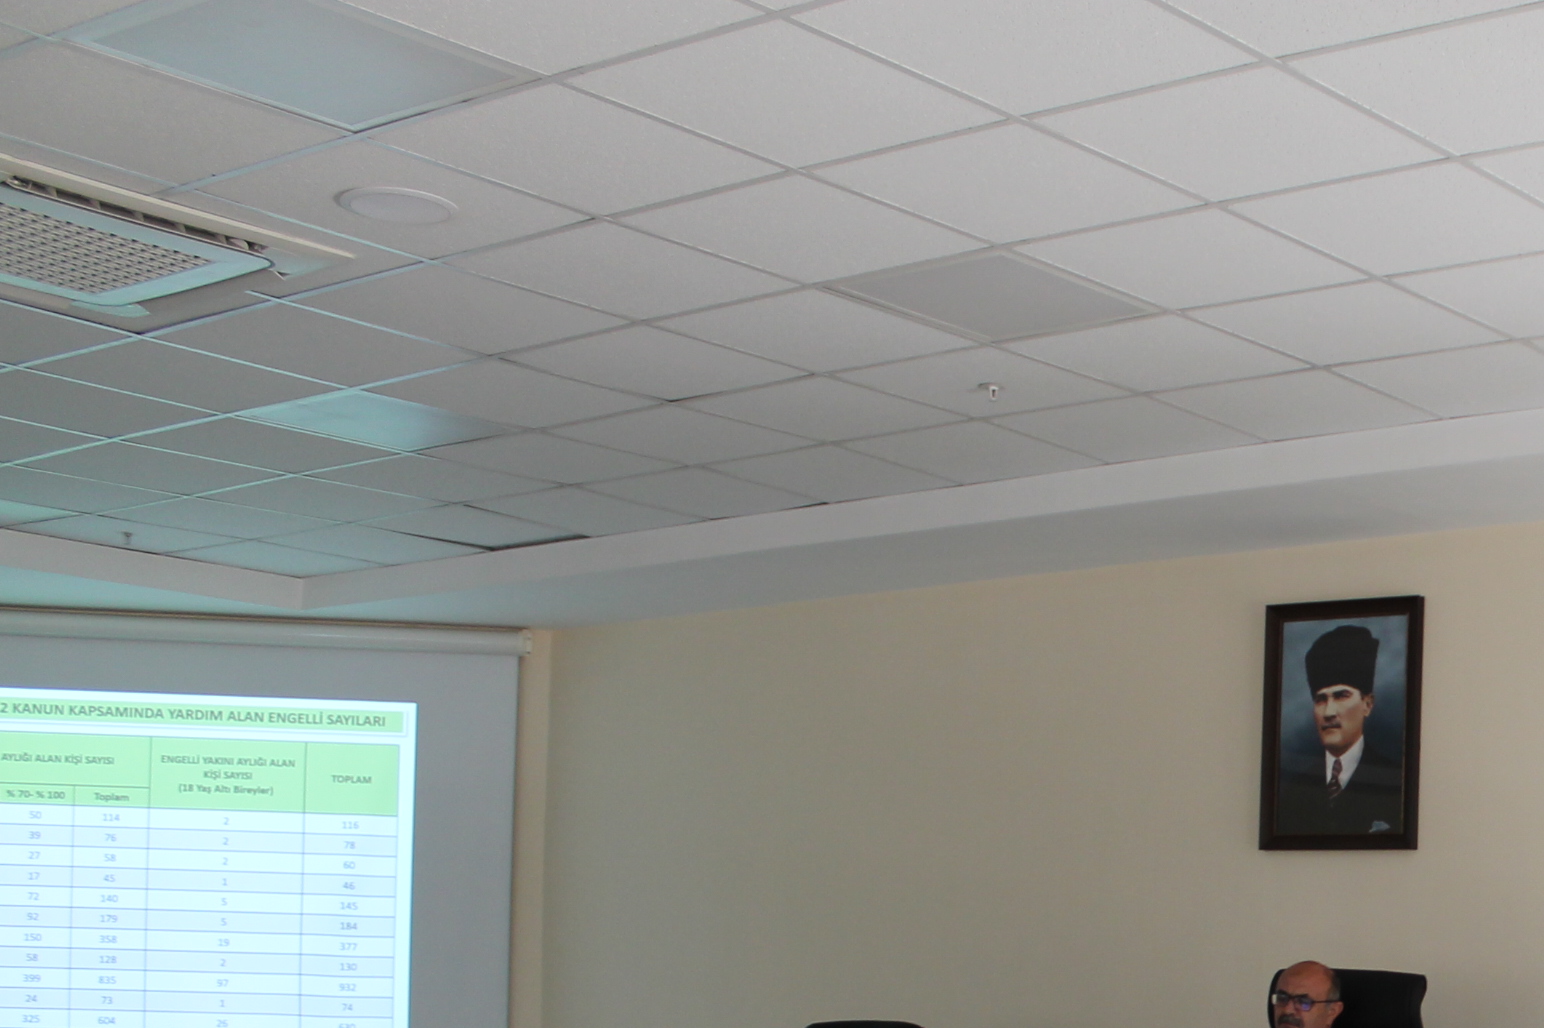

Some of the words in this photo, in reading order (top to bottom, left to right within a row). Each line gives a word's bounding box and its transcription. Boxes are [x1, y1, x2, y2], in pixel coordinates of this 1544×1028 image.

[12, 703, 65, 715] KANUN
[69, 705, 165, 719] KAPSAMINDA
[168, 708, 223, 721] YARDIM
[227, 710, 264, 723] ALAN
[268, 711, 323, 725] ENGELLİ
[326, 714, 386, 727] SAYILARI
[35, 754, 62, 763] ALAN
[85, 755, 115, 765] SAYISI
[160, 753, 201, 765] ENGELLİ
[202, 755, 235, 766] YAKINI
[269, 758, 296, 768] ALAN
[223, 771, 253, 780] SAYISI
[331, 774, 373, 784] TOPLAM
[178, 782, 195, 794] (18
[233, 785, 274, 797] Bireyler)
[47, 790, 66, 800] 100
[94, 792, 130, 804] Toplam
[28, 810, 43, 820] 50
[102, 813, 121, 822] 114
[341, 820, 360, 830] 116
[27, 830, 42, 840] 39
[104, 832, 117, 843] 76
[343, 840, 356, 850] 78
[27, 850, 41, 860] 27
[103, 853, 117, 863] 58
[342, 860, 356, 870] 60
[27, 871, 41, 881] 17
[102, 874, 116, 883] 45
[342, 881, 356, 891] 46
[27, 891, 40, 901] 72
[100, 894, 119, 903] 140
[340, 901, 359, 911] 145
[25, 911, 39, 922] 92
[99, 913, 118, 924] 179
[339, 921, 358, 931] 184
[23, 932, 43, 942] 150
[98, 934, 118, 944] 358
[217, 937, 231, 948] 19
[339, 941, 358, 952] 377
[25, 952, 39, 962] 58
[99, 955, 117, 964] 128
[339, 962, 358, 972] 130
[22, 973, 41, 983] 399
[97, 975, 117, 985] 835
[216, 978, 230, 988] 97
[338, 982, 357, 993] 932
[24, 994, 38, 1003] 24
[100, 995, 114, 1005] 73
[341, 1002, 354, 1012] 74
[21, 1014, 41, 1024] 325
[97, 1016, 116, 1025] 604
[215, 1018, 229, 1028] 26
